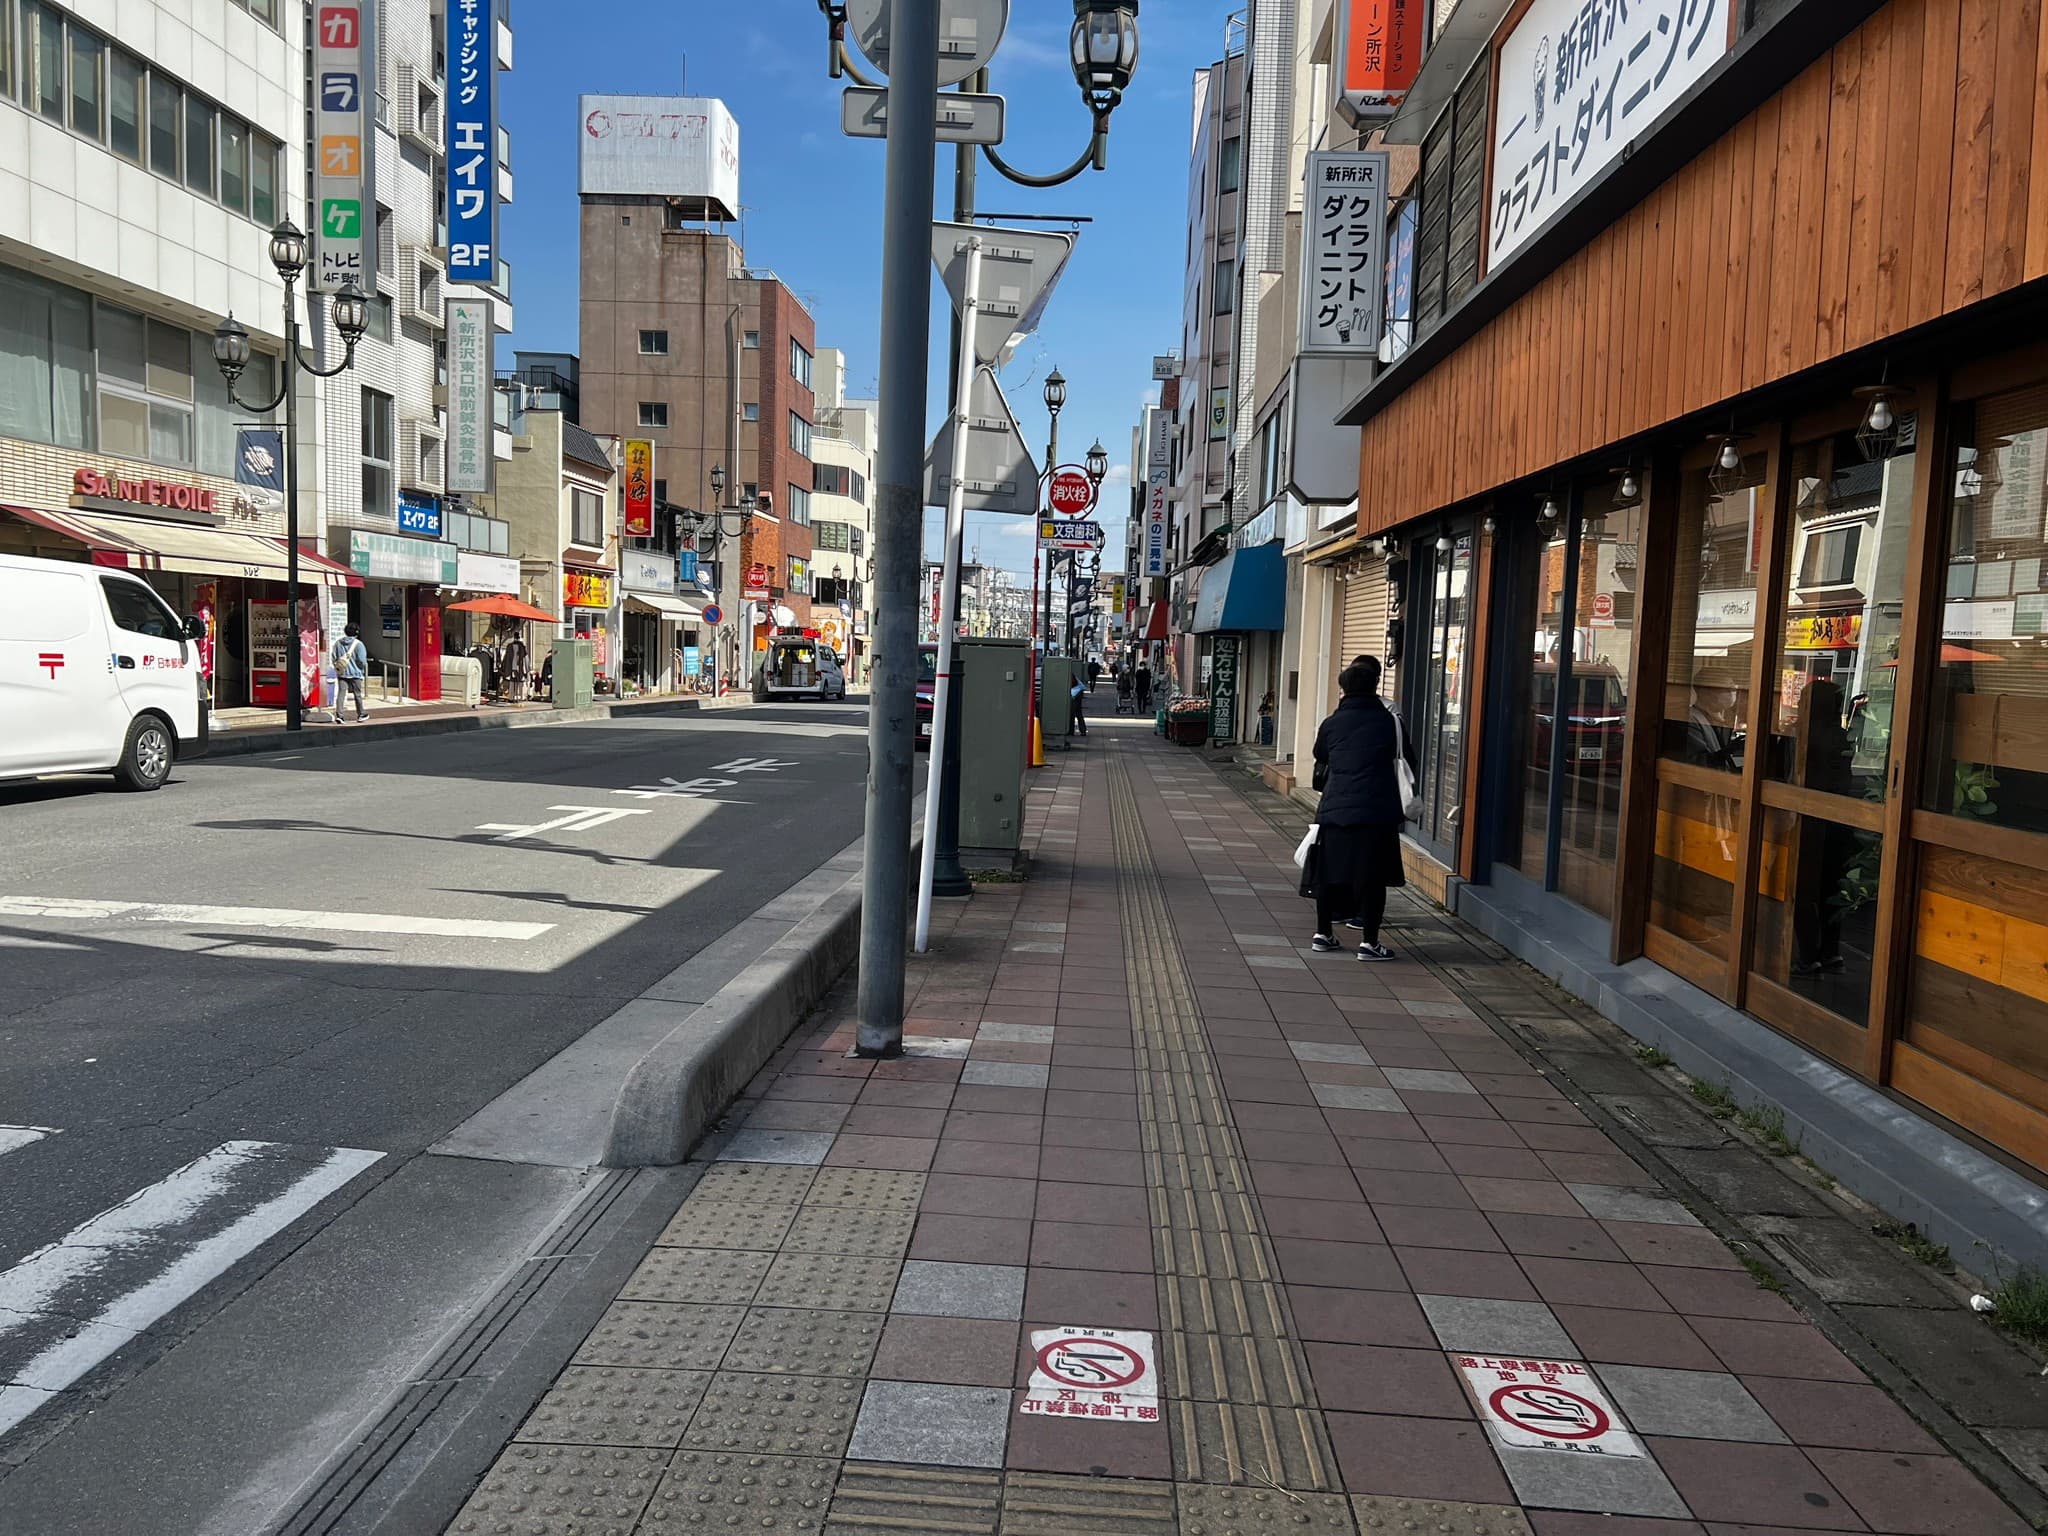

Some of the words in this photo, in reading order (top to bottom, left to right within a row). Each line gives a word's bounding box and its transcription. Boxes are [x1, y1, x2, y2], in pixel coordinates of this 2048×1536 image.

[323, 14, 356, 234] カラオケ
[455, 122, 485, 220] エイワ
[1325, 166, 1373, 183] 新所沢
[451, 244, 490, 267] 2F
[1348, 196, 1370, 302] クラフト
[323, 252, 360, 268] トレビ
[1318, 194, 1347, 328] ダイニング
[323, 273, 339, 283] 4F
[1053, 484, 1088, 503] 消火栓
[403, 510, 426, 529] エイワ
[427, 515, 439, 530] 2F
[1054, 522, 1096, 540] 文京歯科
[1458, 1357, 1587, 1376] 路上喫煙禁止
[1022, 1399, 1157, 1420] 路上喫煙禁止
